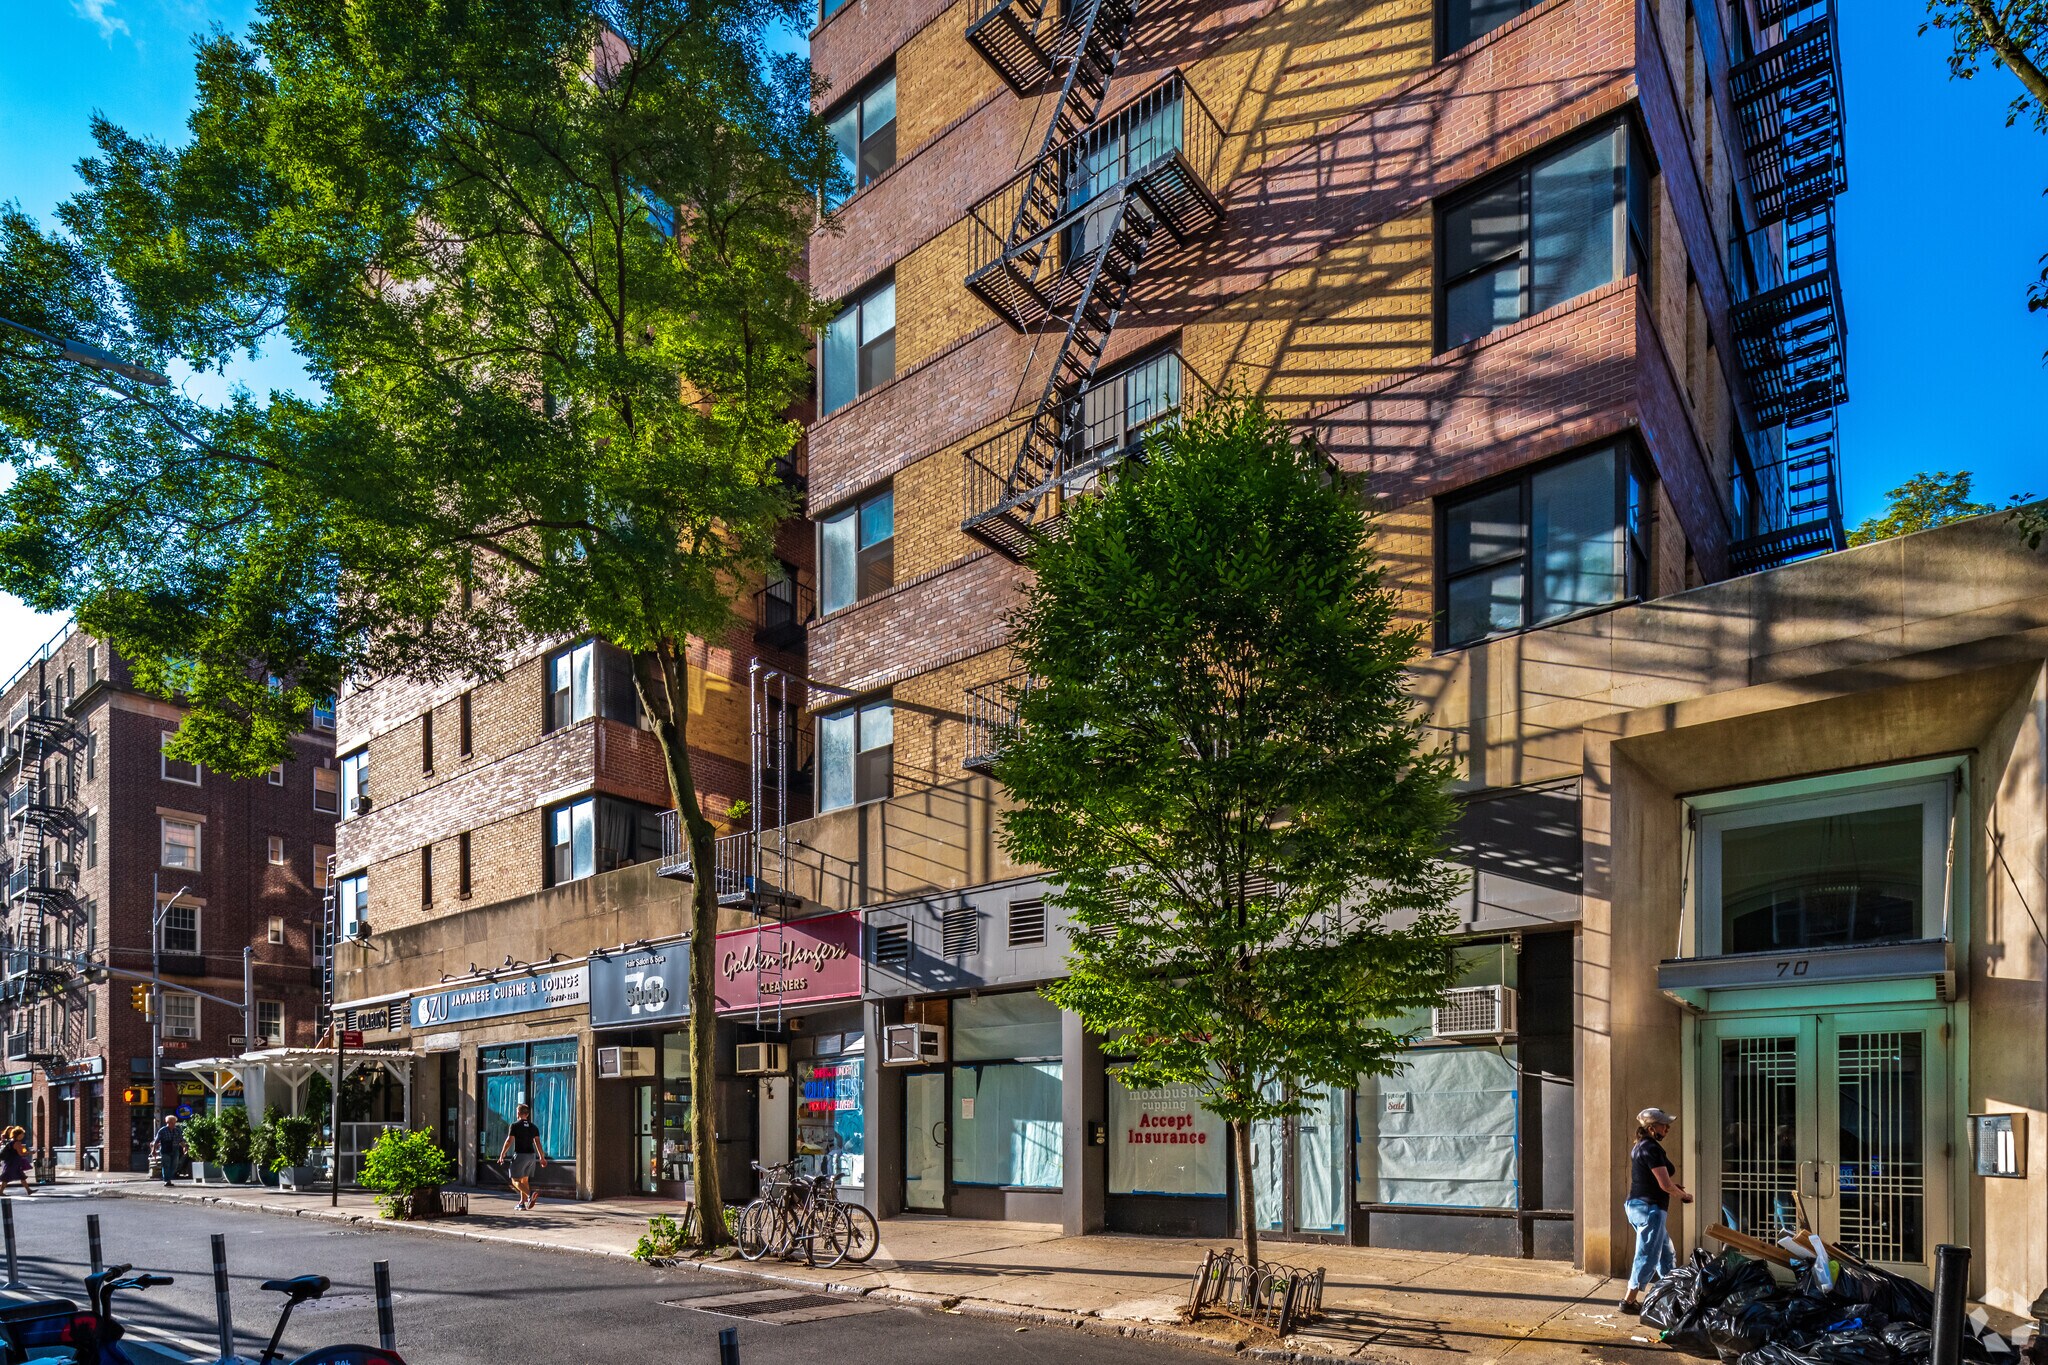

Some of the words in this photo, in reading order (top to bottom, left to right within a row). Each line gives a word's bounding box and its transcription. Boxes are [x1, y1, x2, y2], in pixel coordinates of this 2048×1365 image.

[722, 943, 779, 981] Golden
[1776, 960, 1809, 977] 70
[451, 989, 491, 1007] JAPANESE
[493, 983, 528, 1000] CUISINE
[531, 981, 538, 994] &
[541, 974, 579, 992] LOUNGE
[625, 981, 668, 1007] Studio
[759, 977, 807, 994] CLEANERS
[187, 1083, 202, 1091] C4
[804, 1078, 859, 1099] CLEANERS
[1142, 1099, 1187, 1112] cupping
[1387, 1101, 1405, 1111] Sale
[1140, 1113, 1193, 1130] Accept
[1128, 1129, 1207, 1144] Insurance
